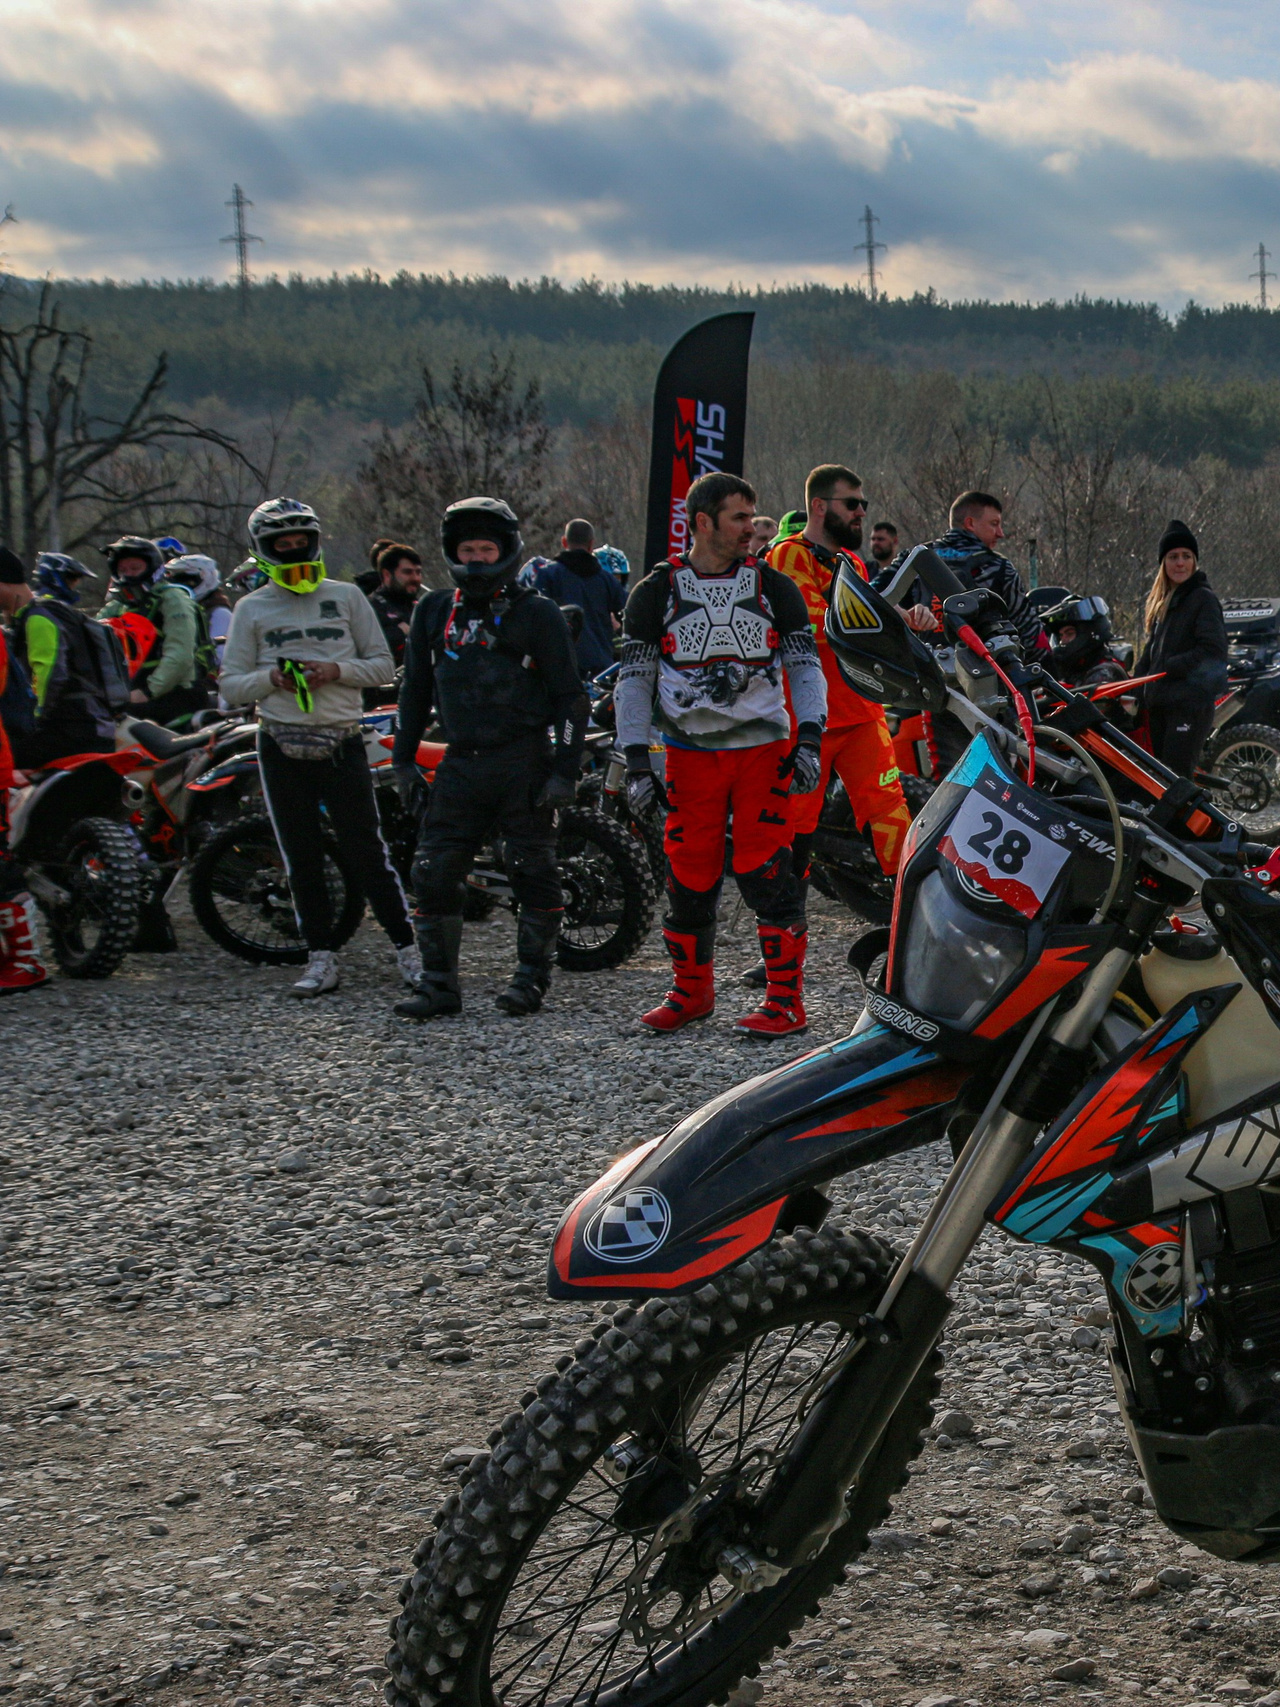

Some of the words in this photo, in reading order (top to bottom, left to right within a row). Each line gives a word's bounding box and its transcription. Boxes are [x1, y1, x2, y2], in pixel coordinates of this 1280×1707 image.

[670, 497, 688, 557] MOT
[562, 719, 574, 746] LEATT
[967, 811, 1031, 875] 28
[866, 990, 939, 1041] RACING
